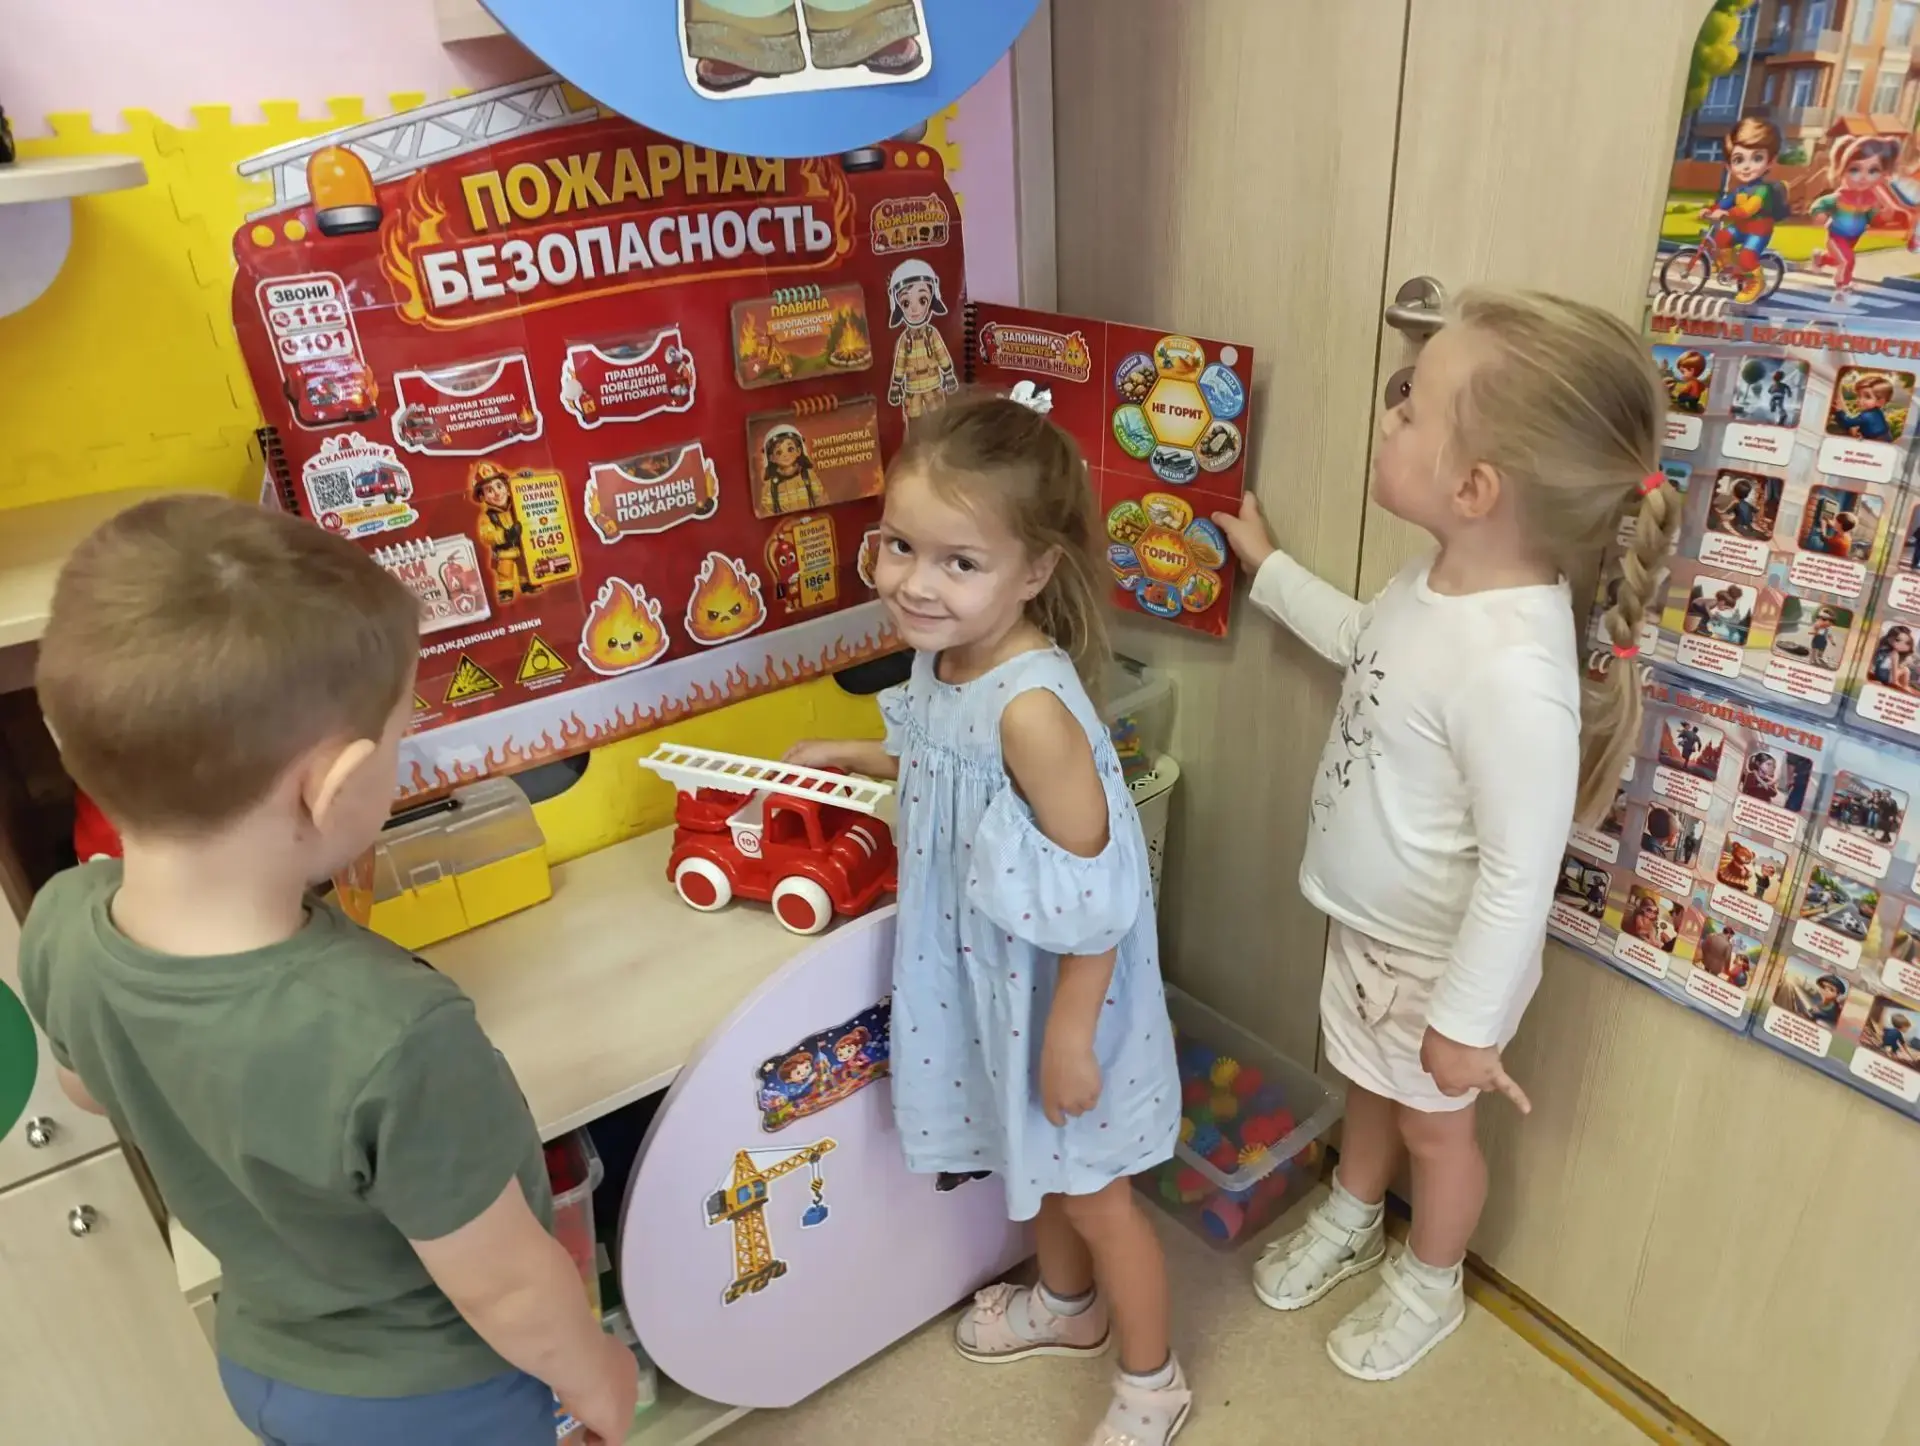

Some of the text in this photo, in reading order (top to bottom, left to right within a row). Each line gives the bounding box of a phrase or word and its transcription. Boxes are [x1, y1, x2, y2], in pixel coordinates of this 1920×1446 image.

[461, 144, 786, 231] ПОЖАРНАЯ
[877, 212, 944, 230] пожарного
[422, 204, 832, 308] БЕЗОПАСНОСТЬ
[274, 285, 329, 303] ЗВОНИ
[293, 303, 342, 325] 112
[771, 298, 829, 317] ПРАВИЛА
[772, 313, 832, 330] БЕЗОПАСНОСТИ
[791, 325, 822, 337] КОСТРА
[300, 331, 346, 353] 101
[1025, 356, 1052, 369] ИГРАТЬ
[605, 363, 659, 382] ПРАВИЛА
[1222, 371, 1237, 390] ВОДА
[600, 374, 667, 395] ПОВЕДЕНИЯ
[428, 393, 515, 416] ПОЖАРНАЯ ТЕХНИКА
[601, 385, 669, 407] ПРИ ПОЖАРЕ
[450, 407, 500, 422] И СРЕДСТВА
[1152, 402, 1204, 420] НЕ ГОРИТ
[446, 413, 518, 432] ПОЖАРОТУШЕНИЯ
[812, 429, 872, 449] ЭКИПИРОВКА
[319, 447, 380, 466] СКАНИРУЙ!
[818, 440, 876, 459] СНАРЯЖЕНИЕ
[817, 452, 873, 469] ПОЖАРНОГО
[1161, 468, 1184, 479] МЕТАЛЛ
[515, 480, 558, 493] ПОЖАРНАЯ
[615, 477, 695, 508] ПРИЧИНЫ
[523, 490, 555, 502] ОХРАНА
[522, 500, 559, 511] ПОЯВИЛАСЬ
[532, 507, 557, 517] РОССИИ
[617, 491, 697, 522] ПОЖАРОВ
[539, 525, 561, 533] АПРЕЛЯ
[800, 525, 826, 537] ПЕРВЫЙ
[530, 531, 565, 549] 1649
[541, 548, 557, 556] ГОДА
[1142, 544, 1187, 567] ГОРИТ!
[805, 571, 831, 589] 1864
[508, 618, 542, 633] знаки
[742, 838, 757, 848] 101
